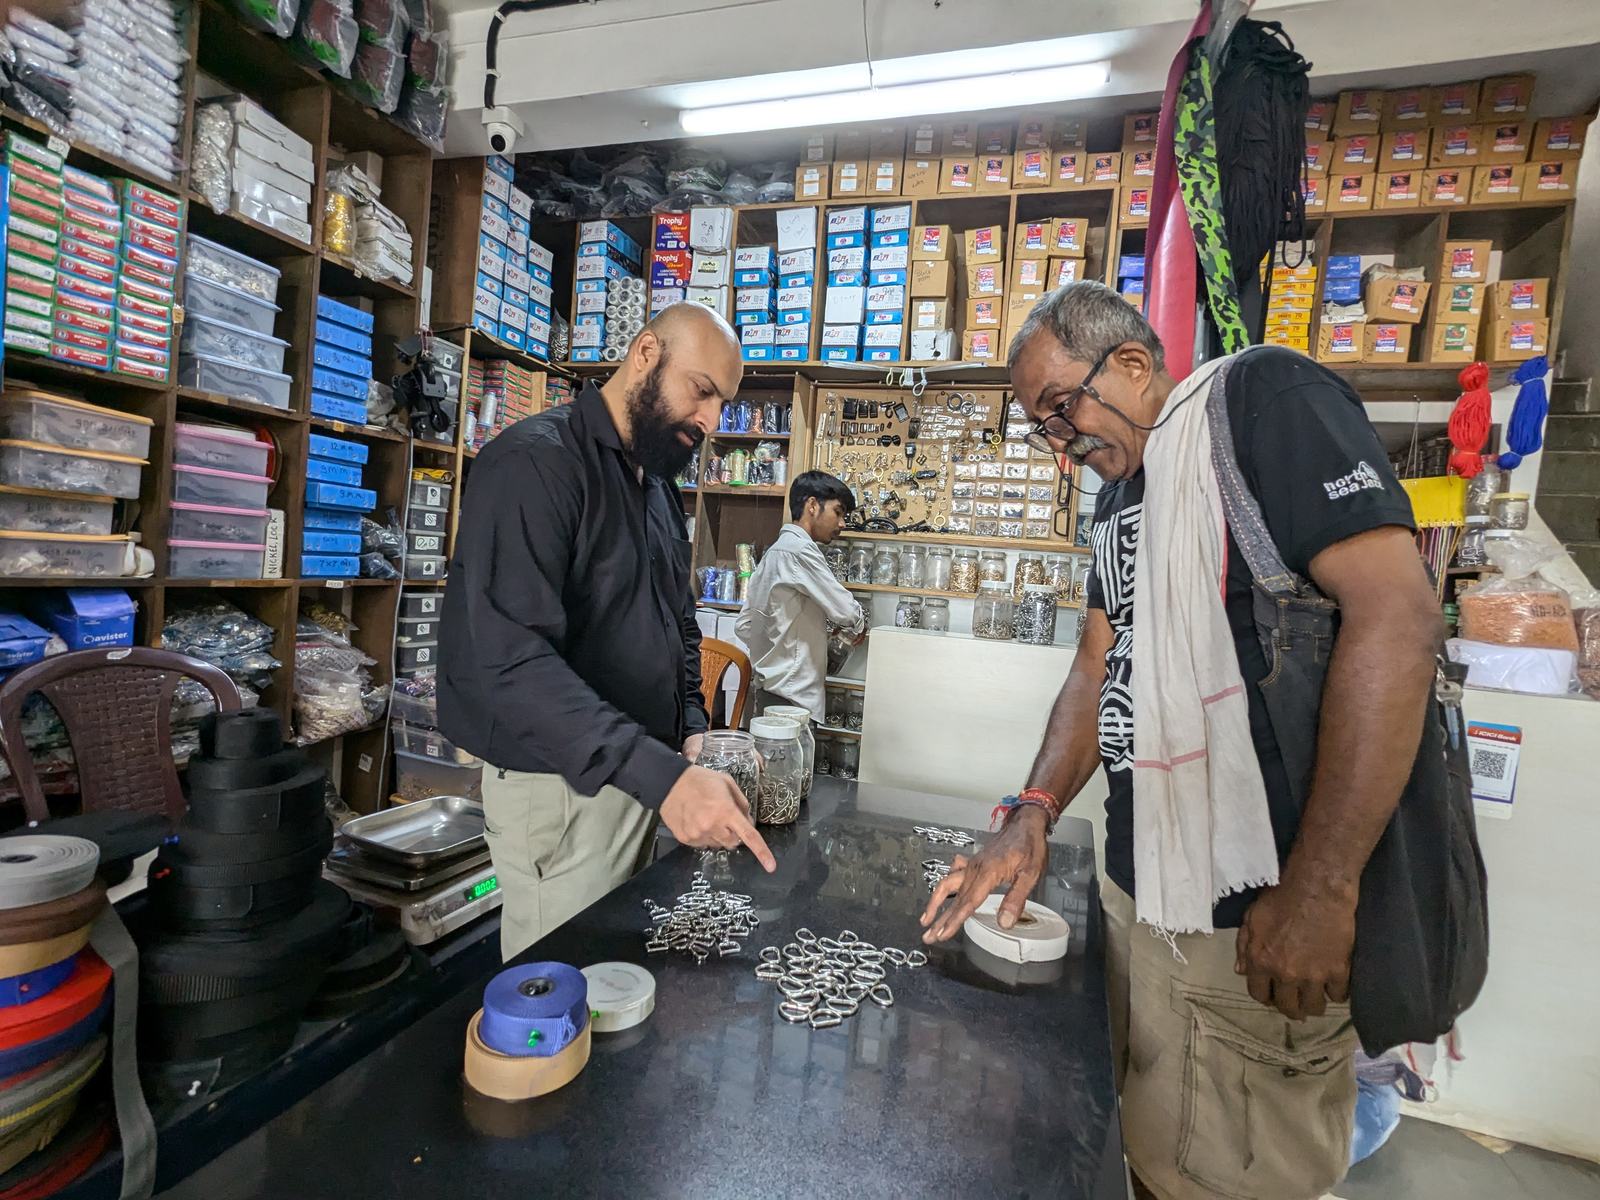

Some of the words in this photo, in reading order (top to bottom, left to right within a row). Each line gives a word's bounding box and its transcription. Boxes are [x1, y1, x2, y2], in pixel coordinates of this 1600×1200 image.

[660, 217, 682, 225] Trophy
[655, 254, 678, 262] Trophy
[1323, 466, 1369, 492] north
[1328, 482, 1360, 500] sea
[269, 517, 278, 540] LOCK
[1479, 730, 1497, 738] ICICI
[769, 749, 786, 762] 25
